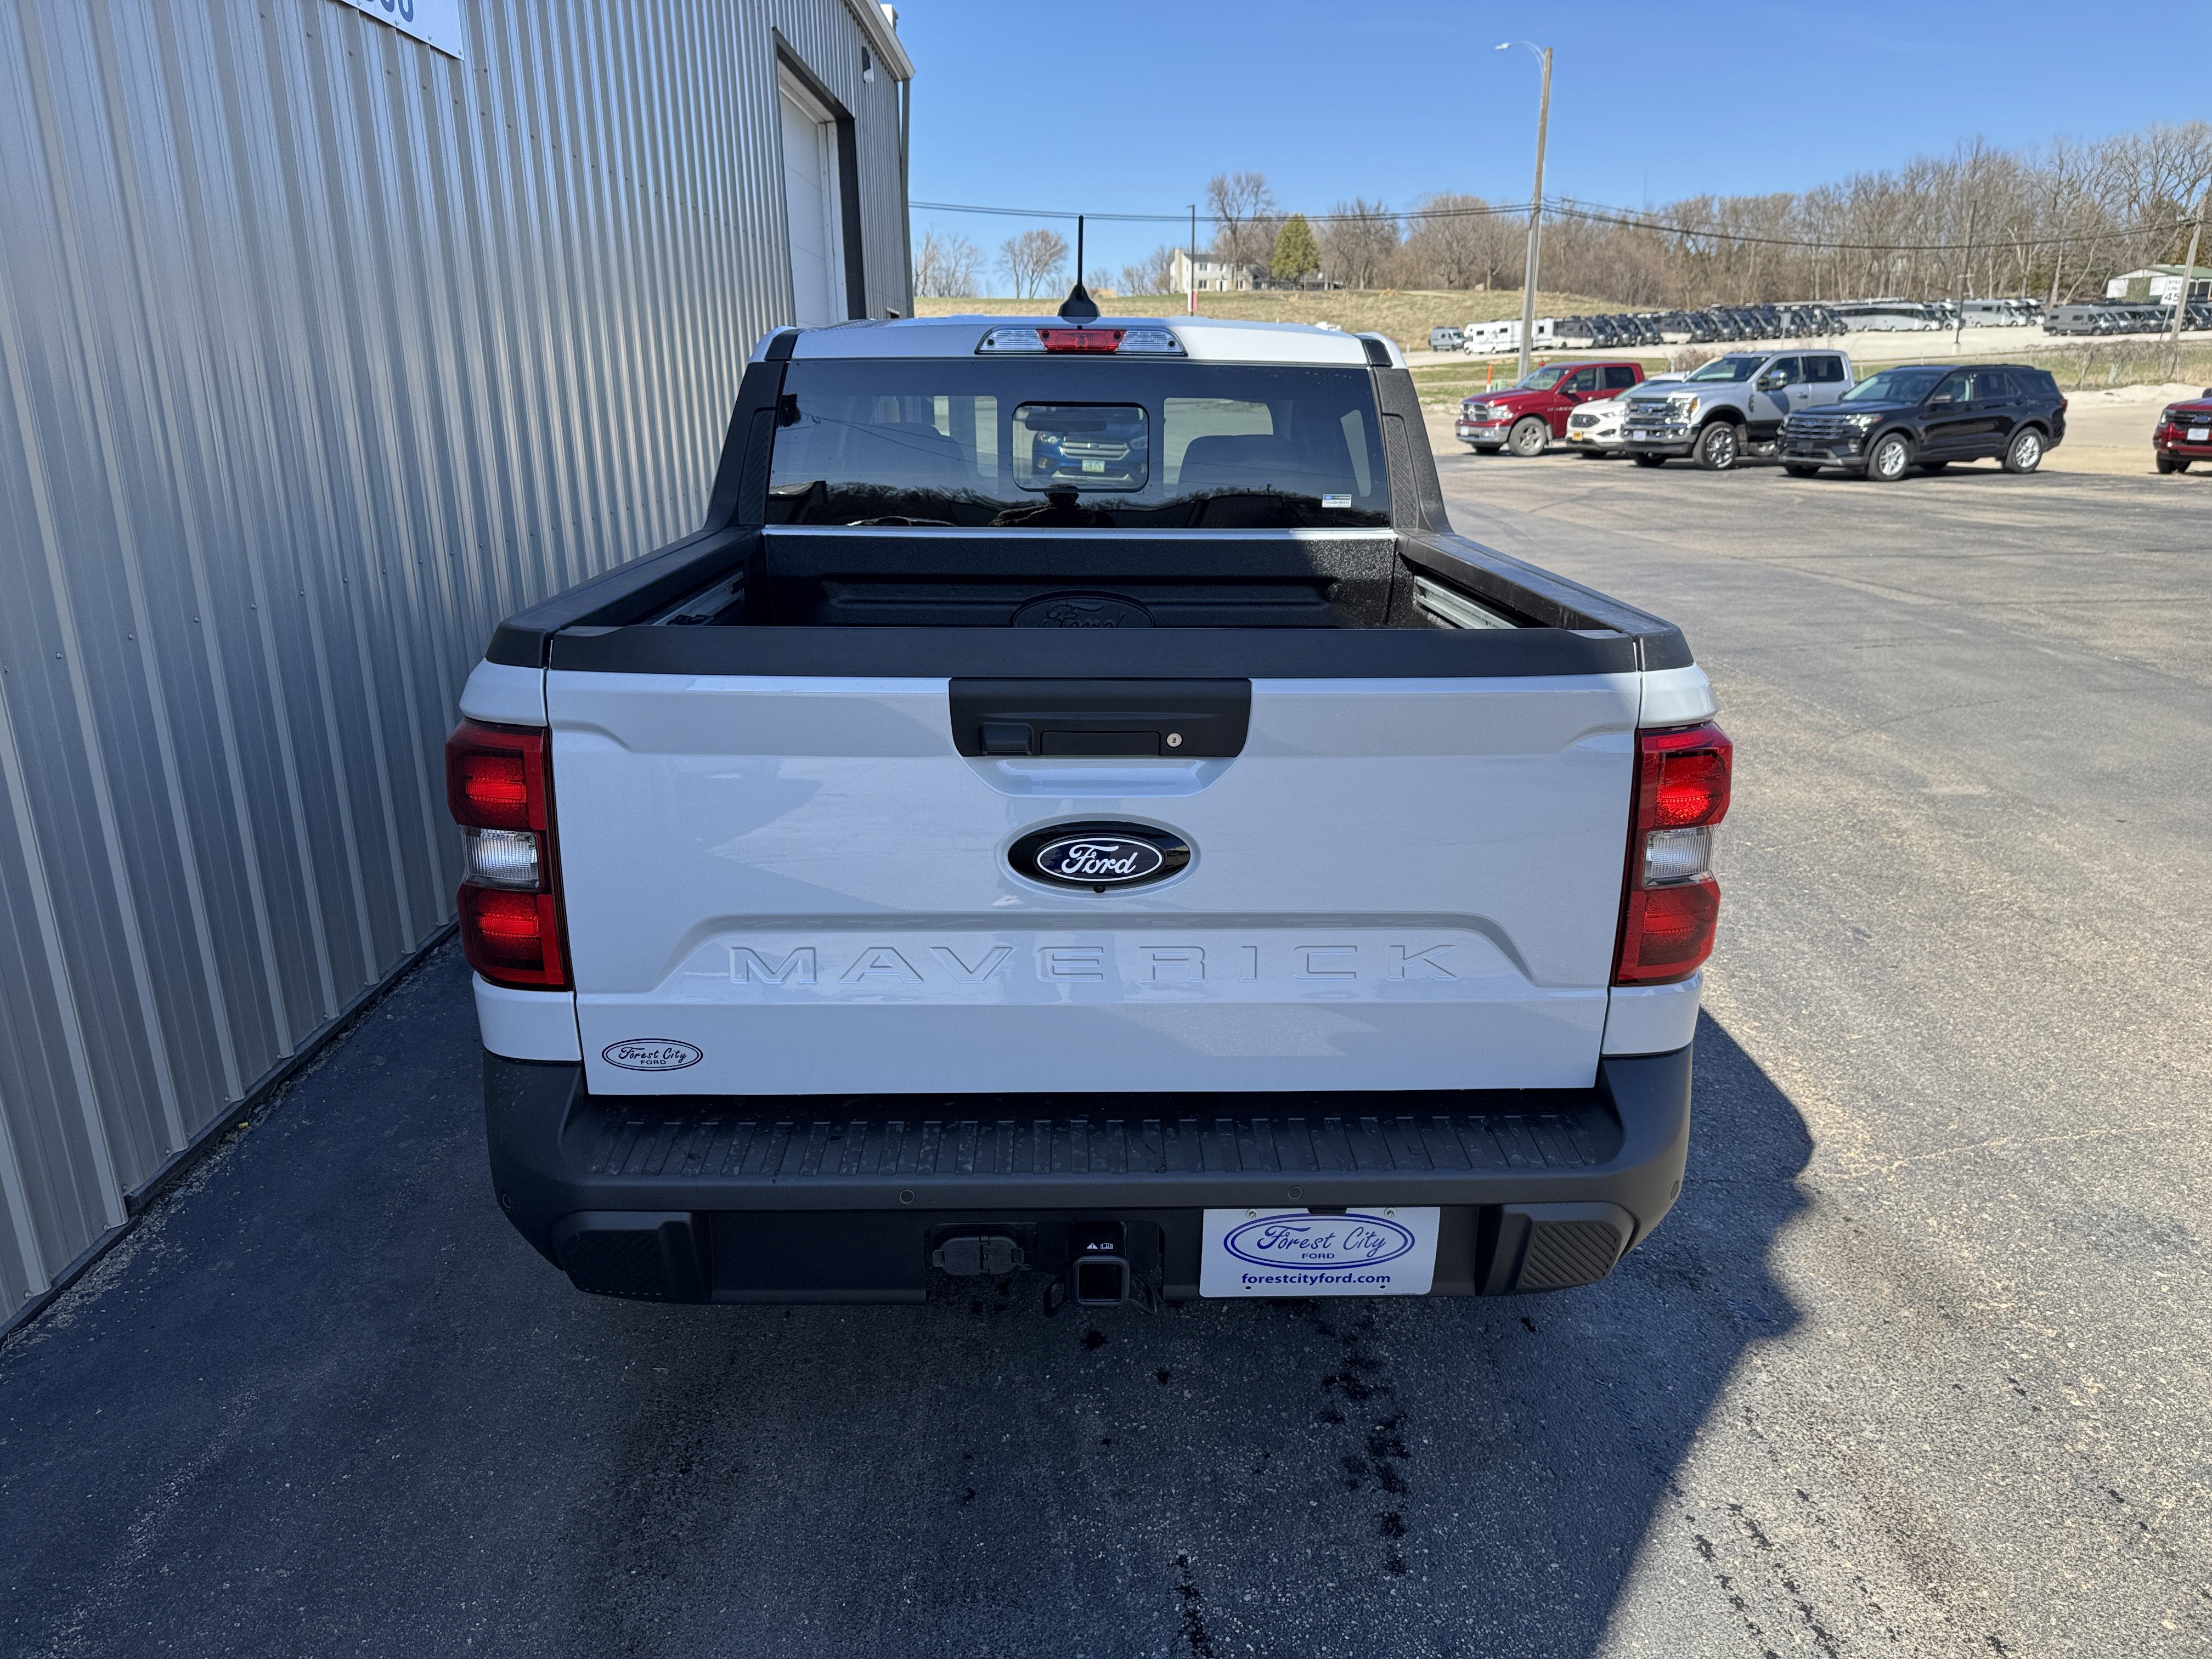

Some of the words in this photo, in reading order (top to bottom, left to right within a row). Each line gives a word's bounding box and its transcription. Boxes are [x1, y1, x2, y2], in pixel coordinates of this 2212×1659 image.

[1061, 844, 1138, 874] Ford
[729, 944, 1458, 984] MAVERICK
[618, 1047, 659, 1059] Forest
[663, 1047, 687, 1063] City
[1257, 1225, 1336, 1250] Forest
[1343, 1226, 1386, 1258] City
[1242, 1273, 1391, 1286] forestcityford.com
